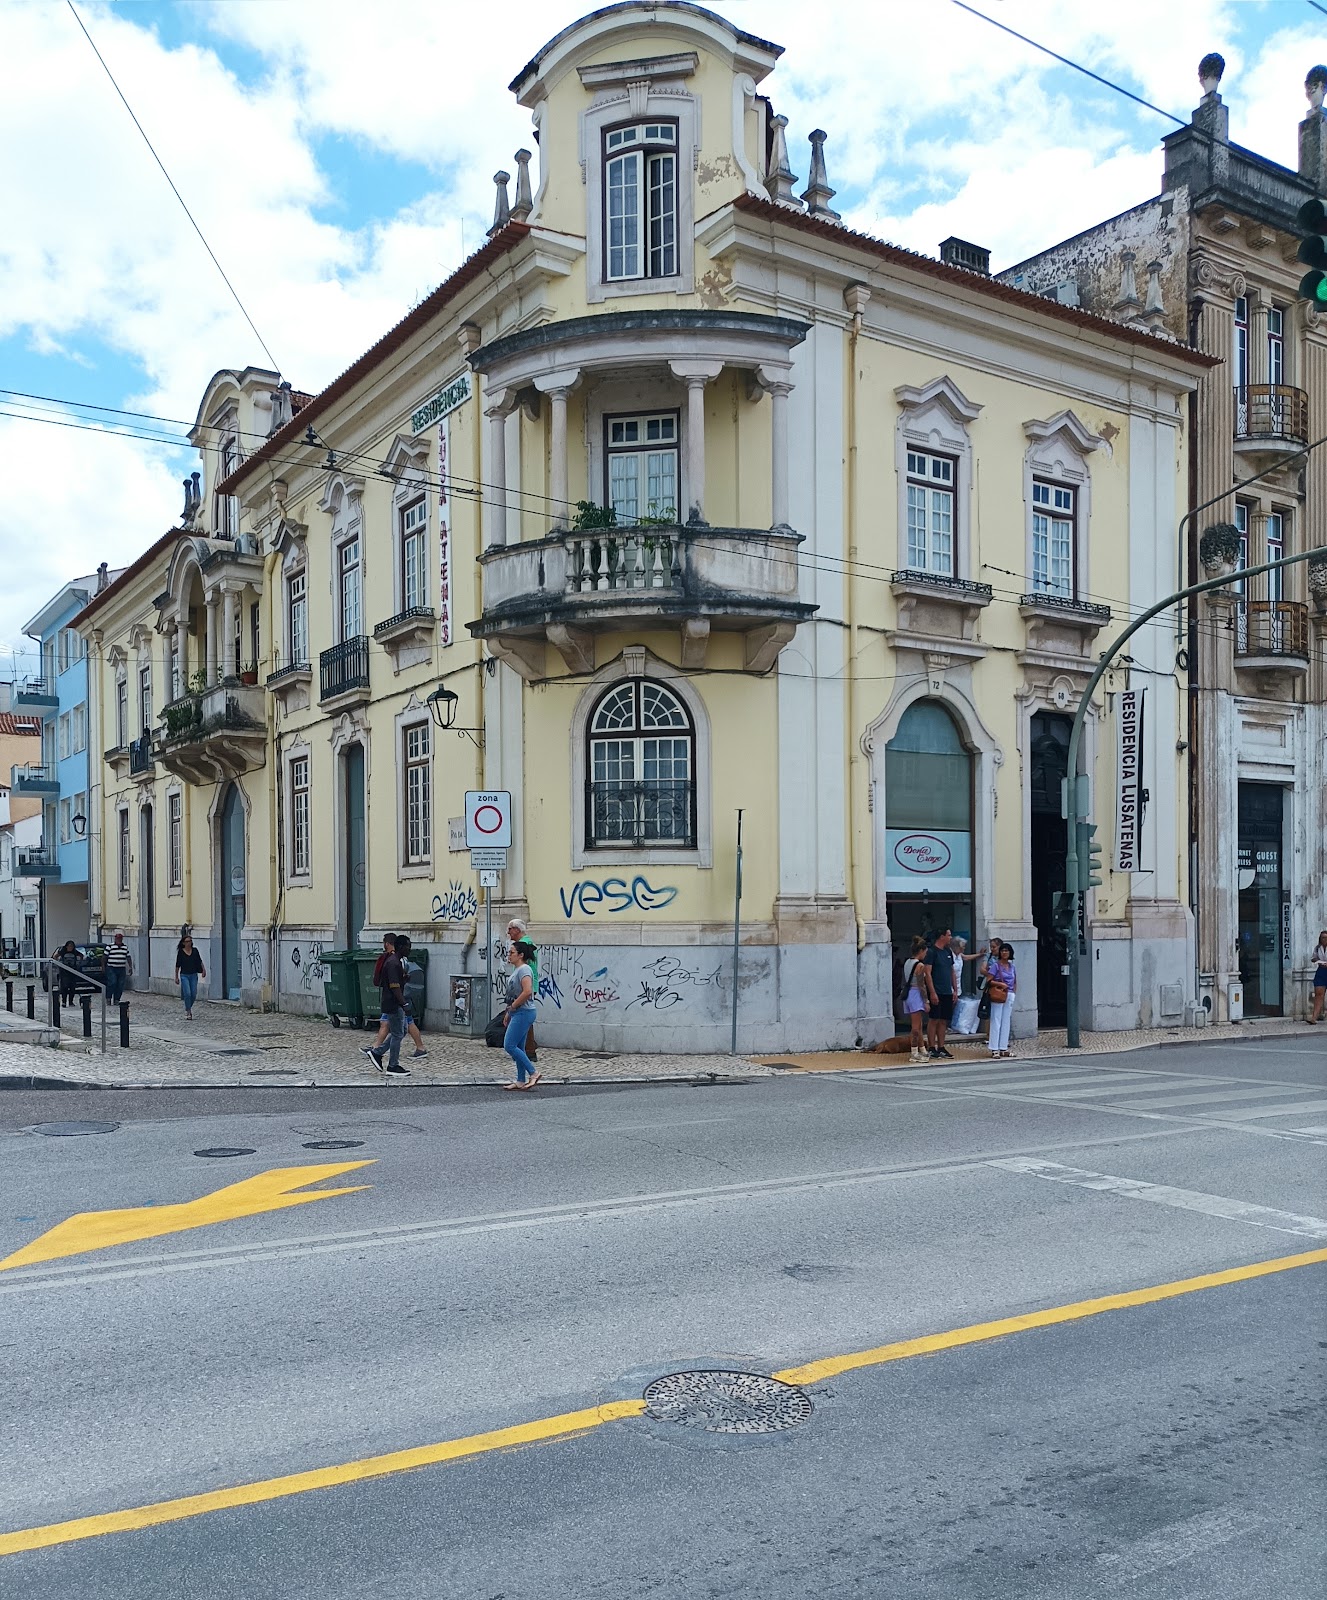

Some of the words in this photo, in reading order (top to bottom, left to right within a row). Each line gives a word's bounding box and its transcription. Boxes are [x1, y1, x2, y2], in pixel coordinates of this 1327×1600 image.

[438, 423, 447, 507] LUSA
[440, 520, 449, 643] ATENAS
[932, 680, 940, 690] 72
[1122, 691, 1136, 780] RESIDENCIA
[1119, 784, 1137, 870] LUSATENAS
[1256, 851, 1278, 860] GUEST
[1256, 864, 1278, 873] HOUSE
